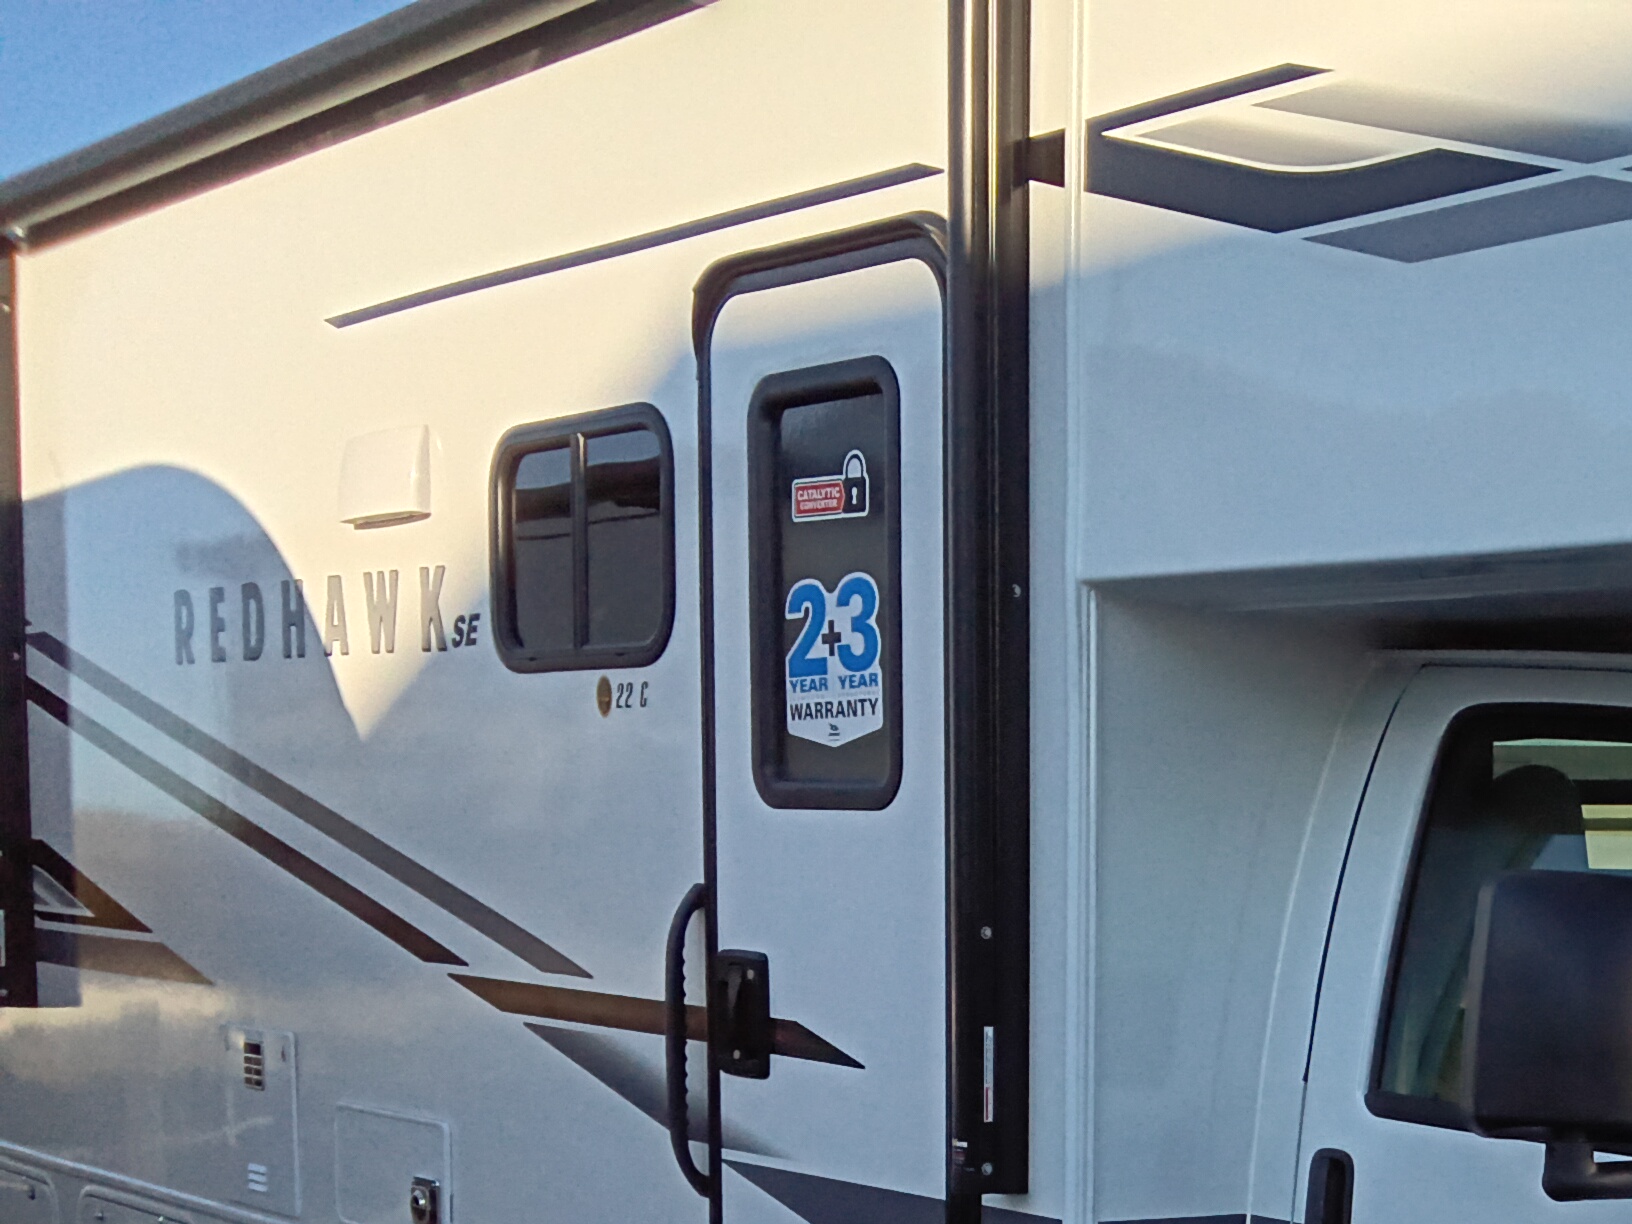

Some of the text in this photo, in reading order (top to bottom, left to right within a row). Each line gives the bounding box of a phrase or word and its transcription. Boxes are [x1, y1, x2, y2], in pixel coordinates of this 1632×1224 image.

[797, 486, 841, 501] CATALYTIC
[173, 564, 481, 666] REDHAWK SE
[616, 680, 649, 709] 22 C
[788, 677, 829, 694] YEAR
[838, 672, 879, 690] YEAR
[790, 697, 879, 721] WARRANTY
